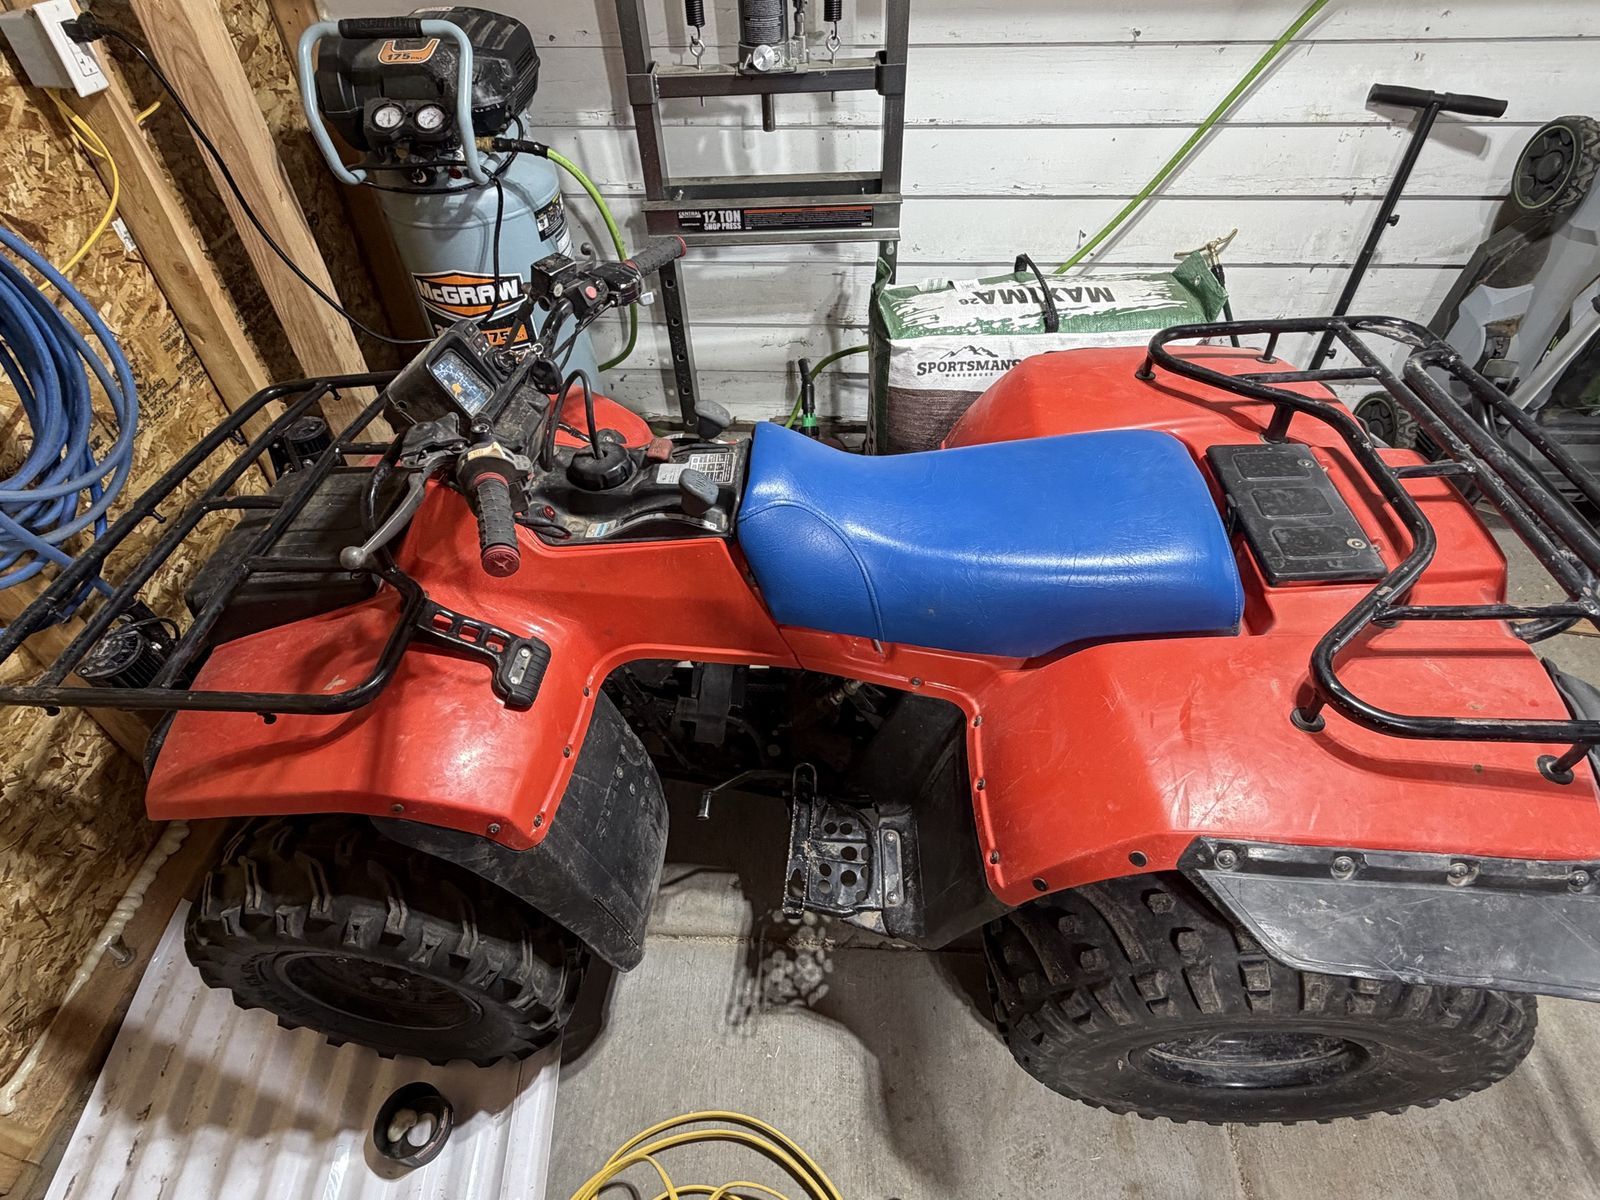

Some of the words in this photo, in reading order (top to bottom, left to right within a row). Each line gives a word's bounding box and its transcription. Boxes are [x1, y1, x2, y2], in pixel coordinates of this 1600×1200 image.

[703, 211, 716, 223] 12
[718, 210, 741, 222] TON
[704, 223, 720, 231] SHOP
[722, 222, 741, 230] PRESS
[415, 278, 519, 304] McGRAW
